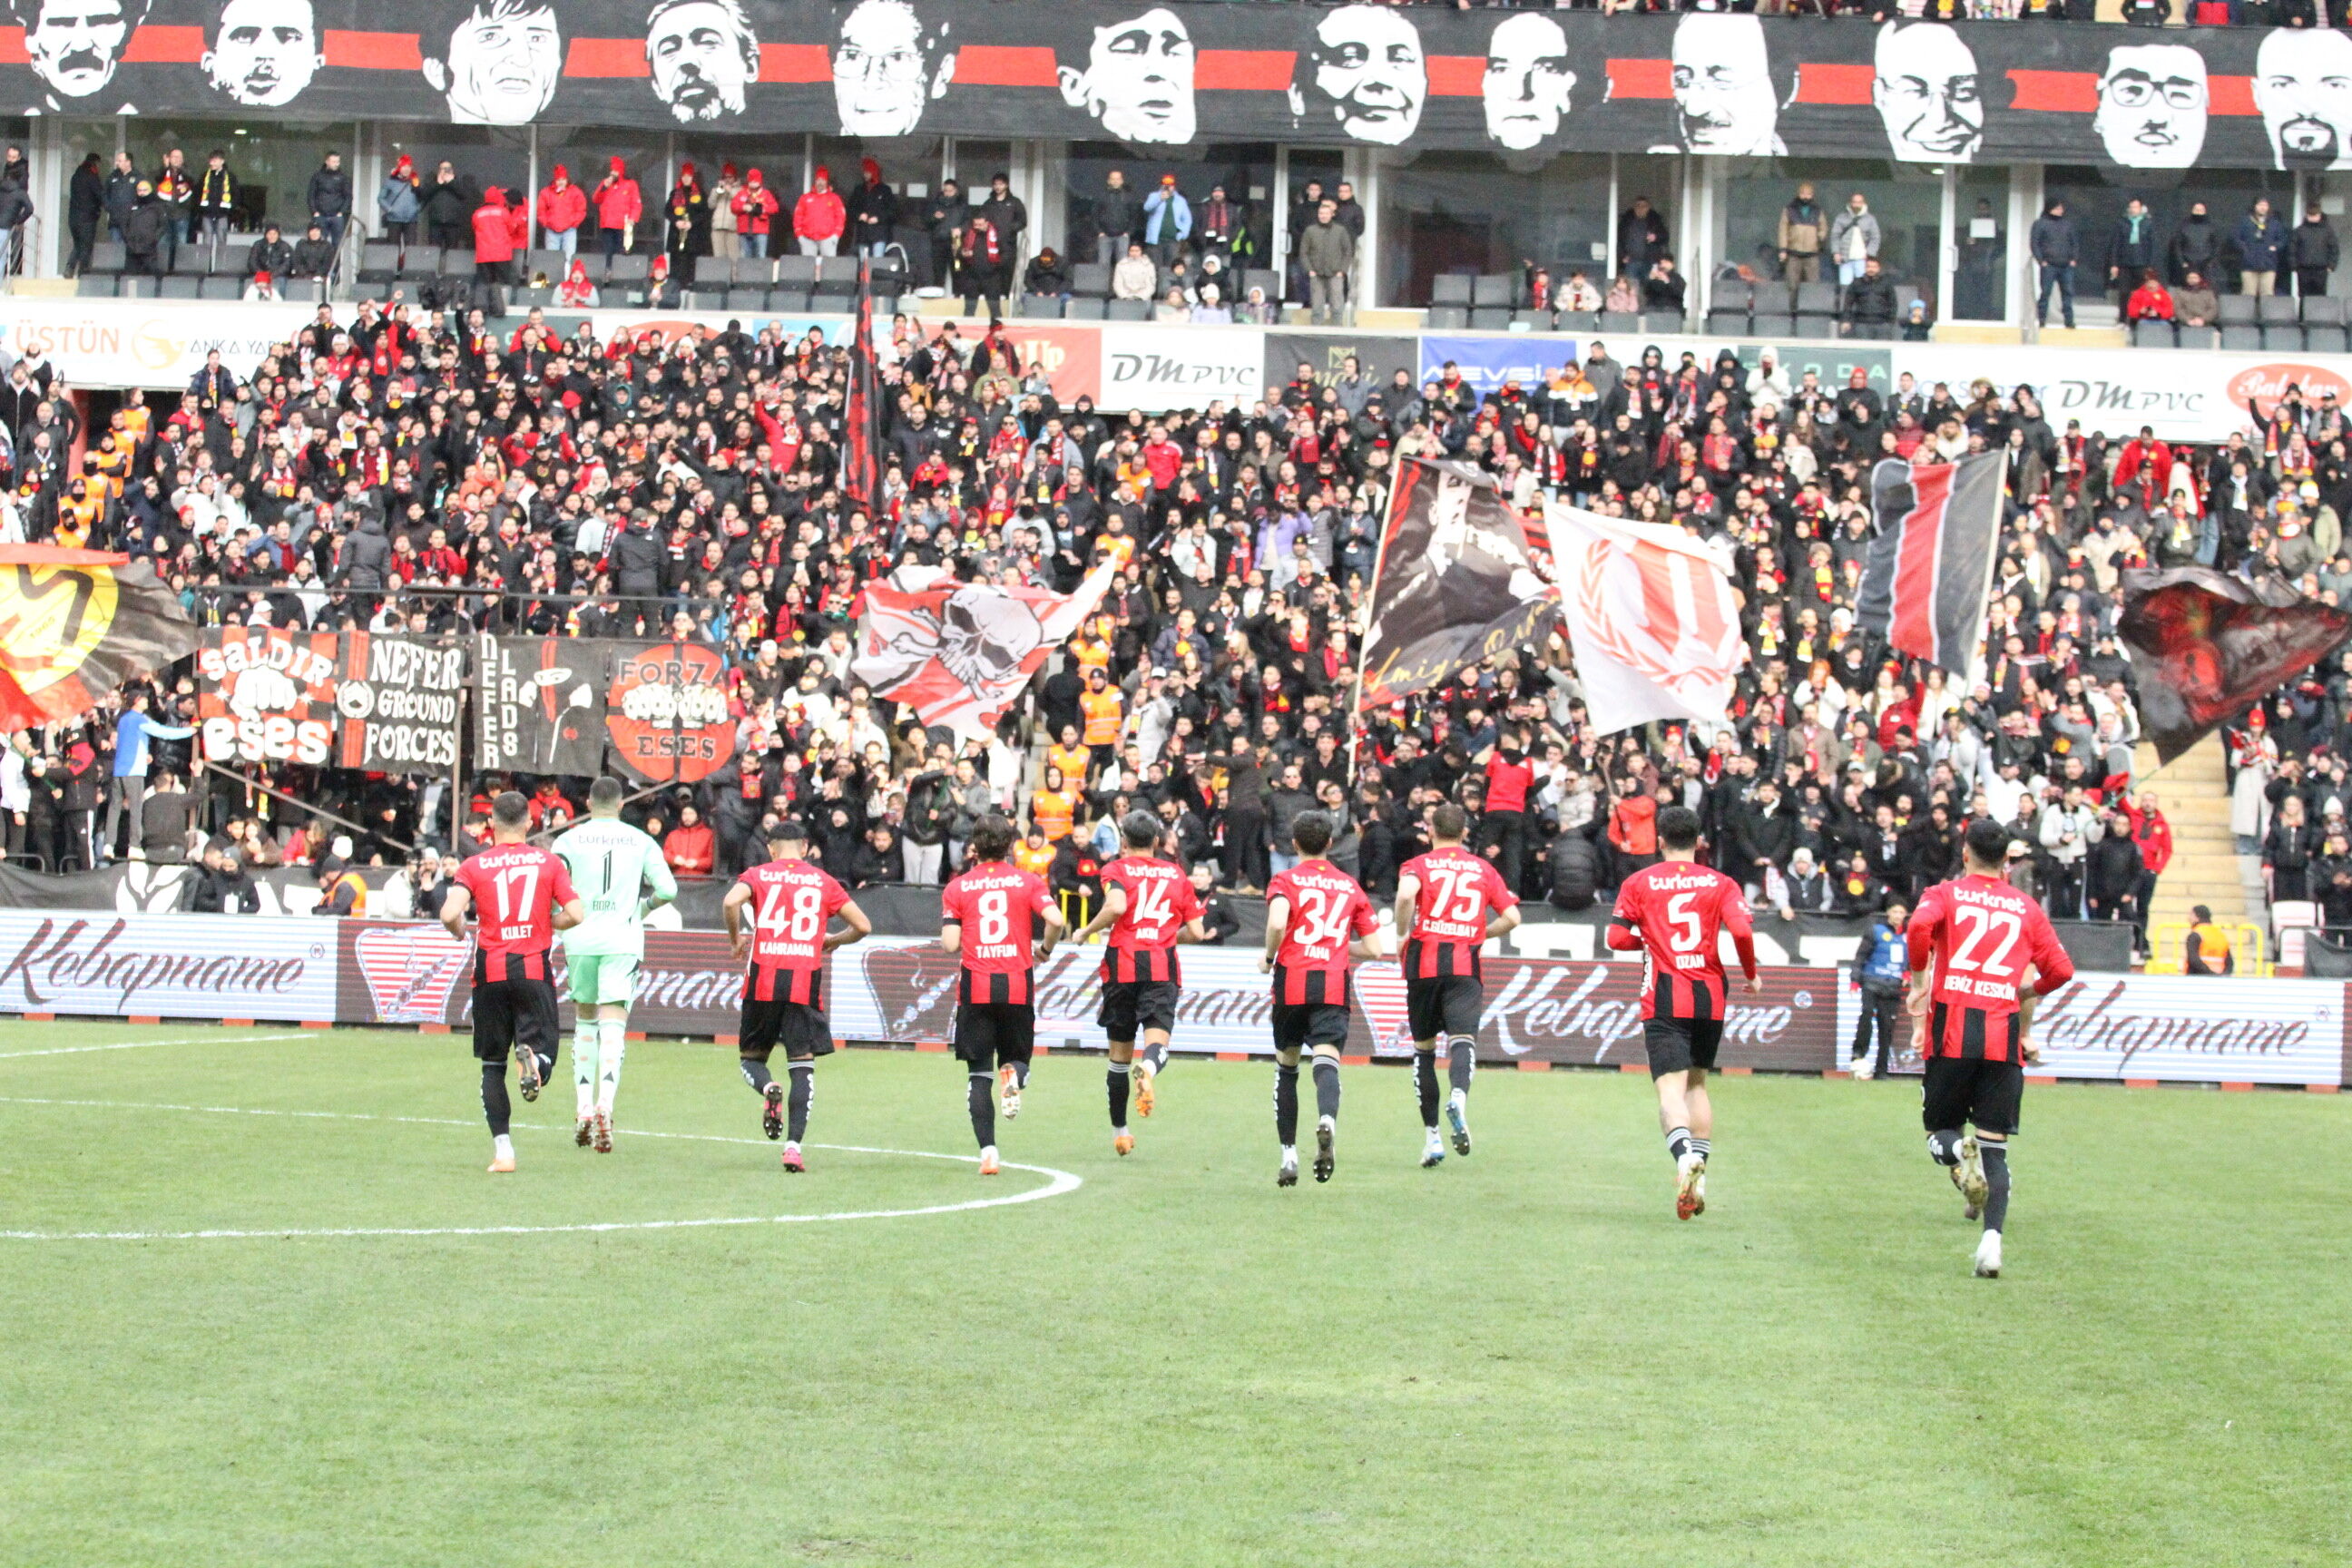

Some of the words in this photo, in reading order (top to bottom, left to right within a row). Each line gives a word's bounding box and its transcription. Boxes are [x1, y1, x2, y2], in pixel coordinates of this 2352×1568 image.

[15, 319, 120, 355] ÜSTÜN
[190, 339, 240, 354] ANKA
[1192, 365, 1257, 386] PVC
[2140, 391, 2204, 413] PVC
[371, 639, 462, 691] NEFER
[377, 691, 456, 722] GROUND
[501, 648, 518, 757] LADS
[364, 722, 456, 767] FORCES
[635, 735, 716, 761] ESES
[578, 834, 638, 847] turknet
[478, 851, 546, 870] turknet
[602, 849, 612, 896] 1
[1124, 863, 1179, 880] turknet
[1425, 857, 1484, 874] turknet
[760, 868, 824, 887] turknet
[960, 874, 1024, 893] turknet
[1291, 873, 1356, 894] turknet
[1648, 873, 1719, 891] turknet
[494, 865, 539, 922] 17
[1132, 877, 1174, 928] 14
[1429, 868, 1482, 922] 75
[1953, 886, 2027, 915] turknet
[758, 884, 822, 941] 48
[978, 890, 1009, 945] 8
[1293, 887, 1351, 948] 34
[1667, 892, 1702, 952] 5
[759, 941, 815, 957] KAHRAMAN
[975, 944, 1017, 959] TAYFUN
[1303, 944, 1331, 962] TAHA
[1948, 905, 2023, 977] 22
[0, 917, 306, 1014] Kebapname
[1675, 954, 1706, 970] OZAN
